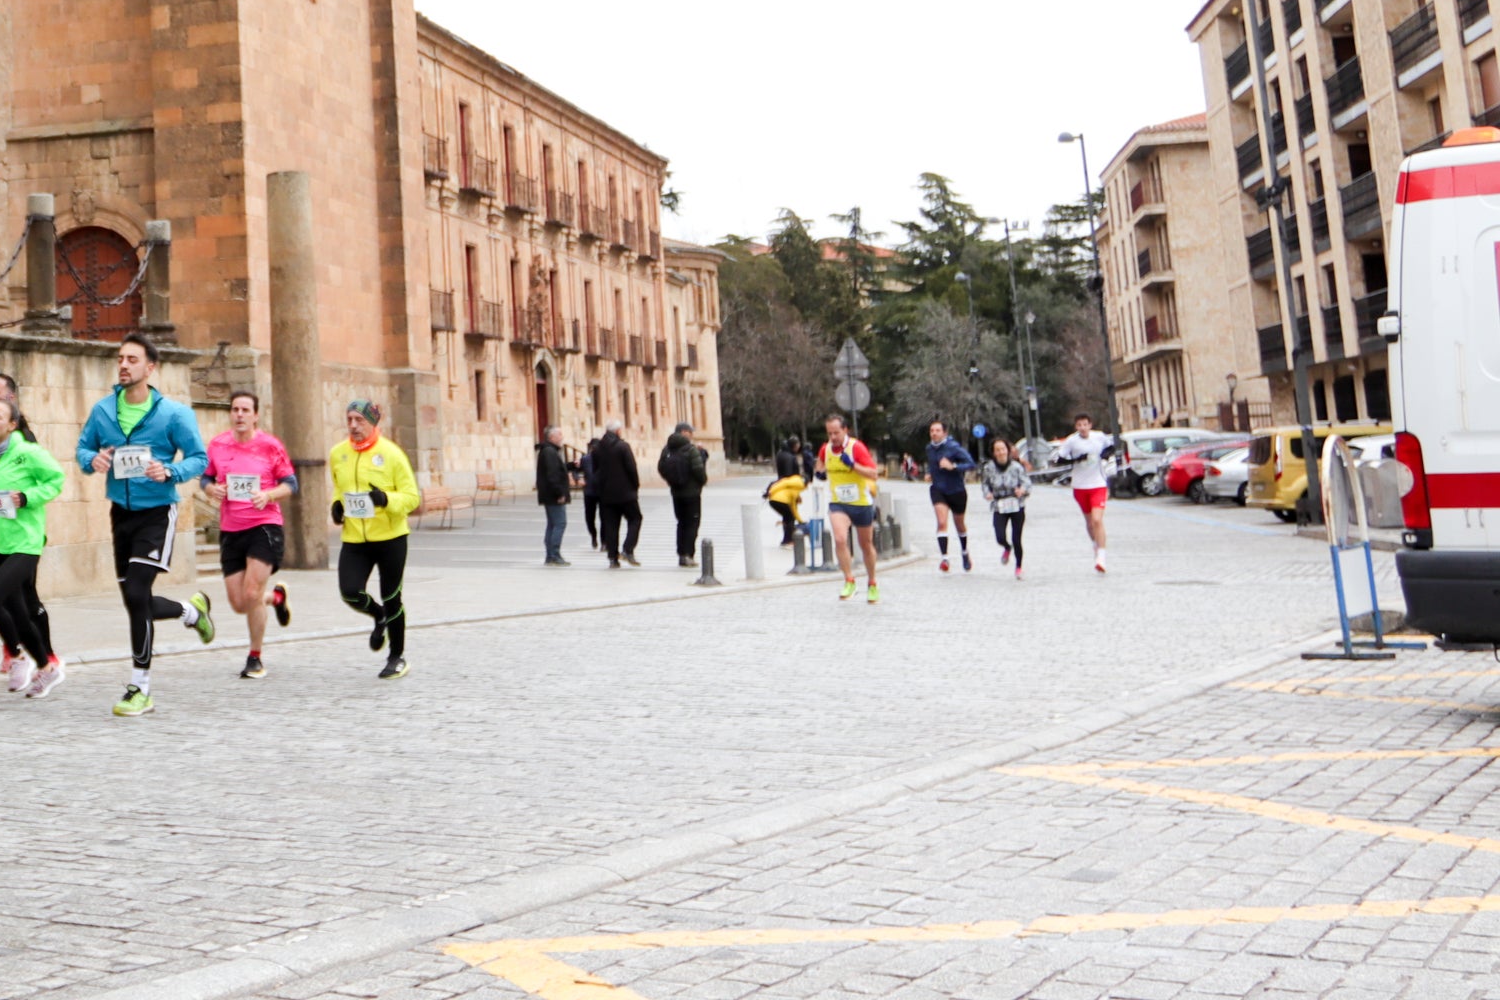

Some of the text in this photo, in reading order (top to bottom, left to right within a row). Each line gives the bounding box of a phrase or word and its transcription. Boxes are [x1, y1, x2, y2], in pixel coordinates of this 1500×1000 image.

[121, 456, 141, 466] 111
[233, 481, 253, 490] 245
[348, 499, 366, 508] 110
